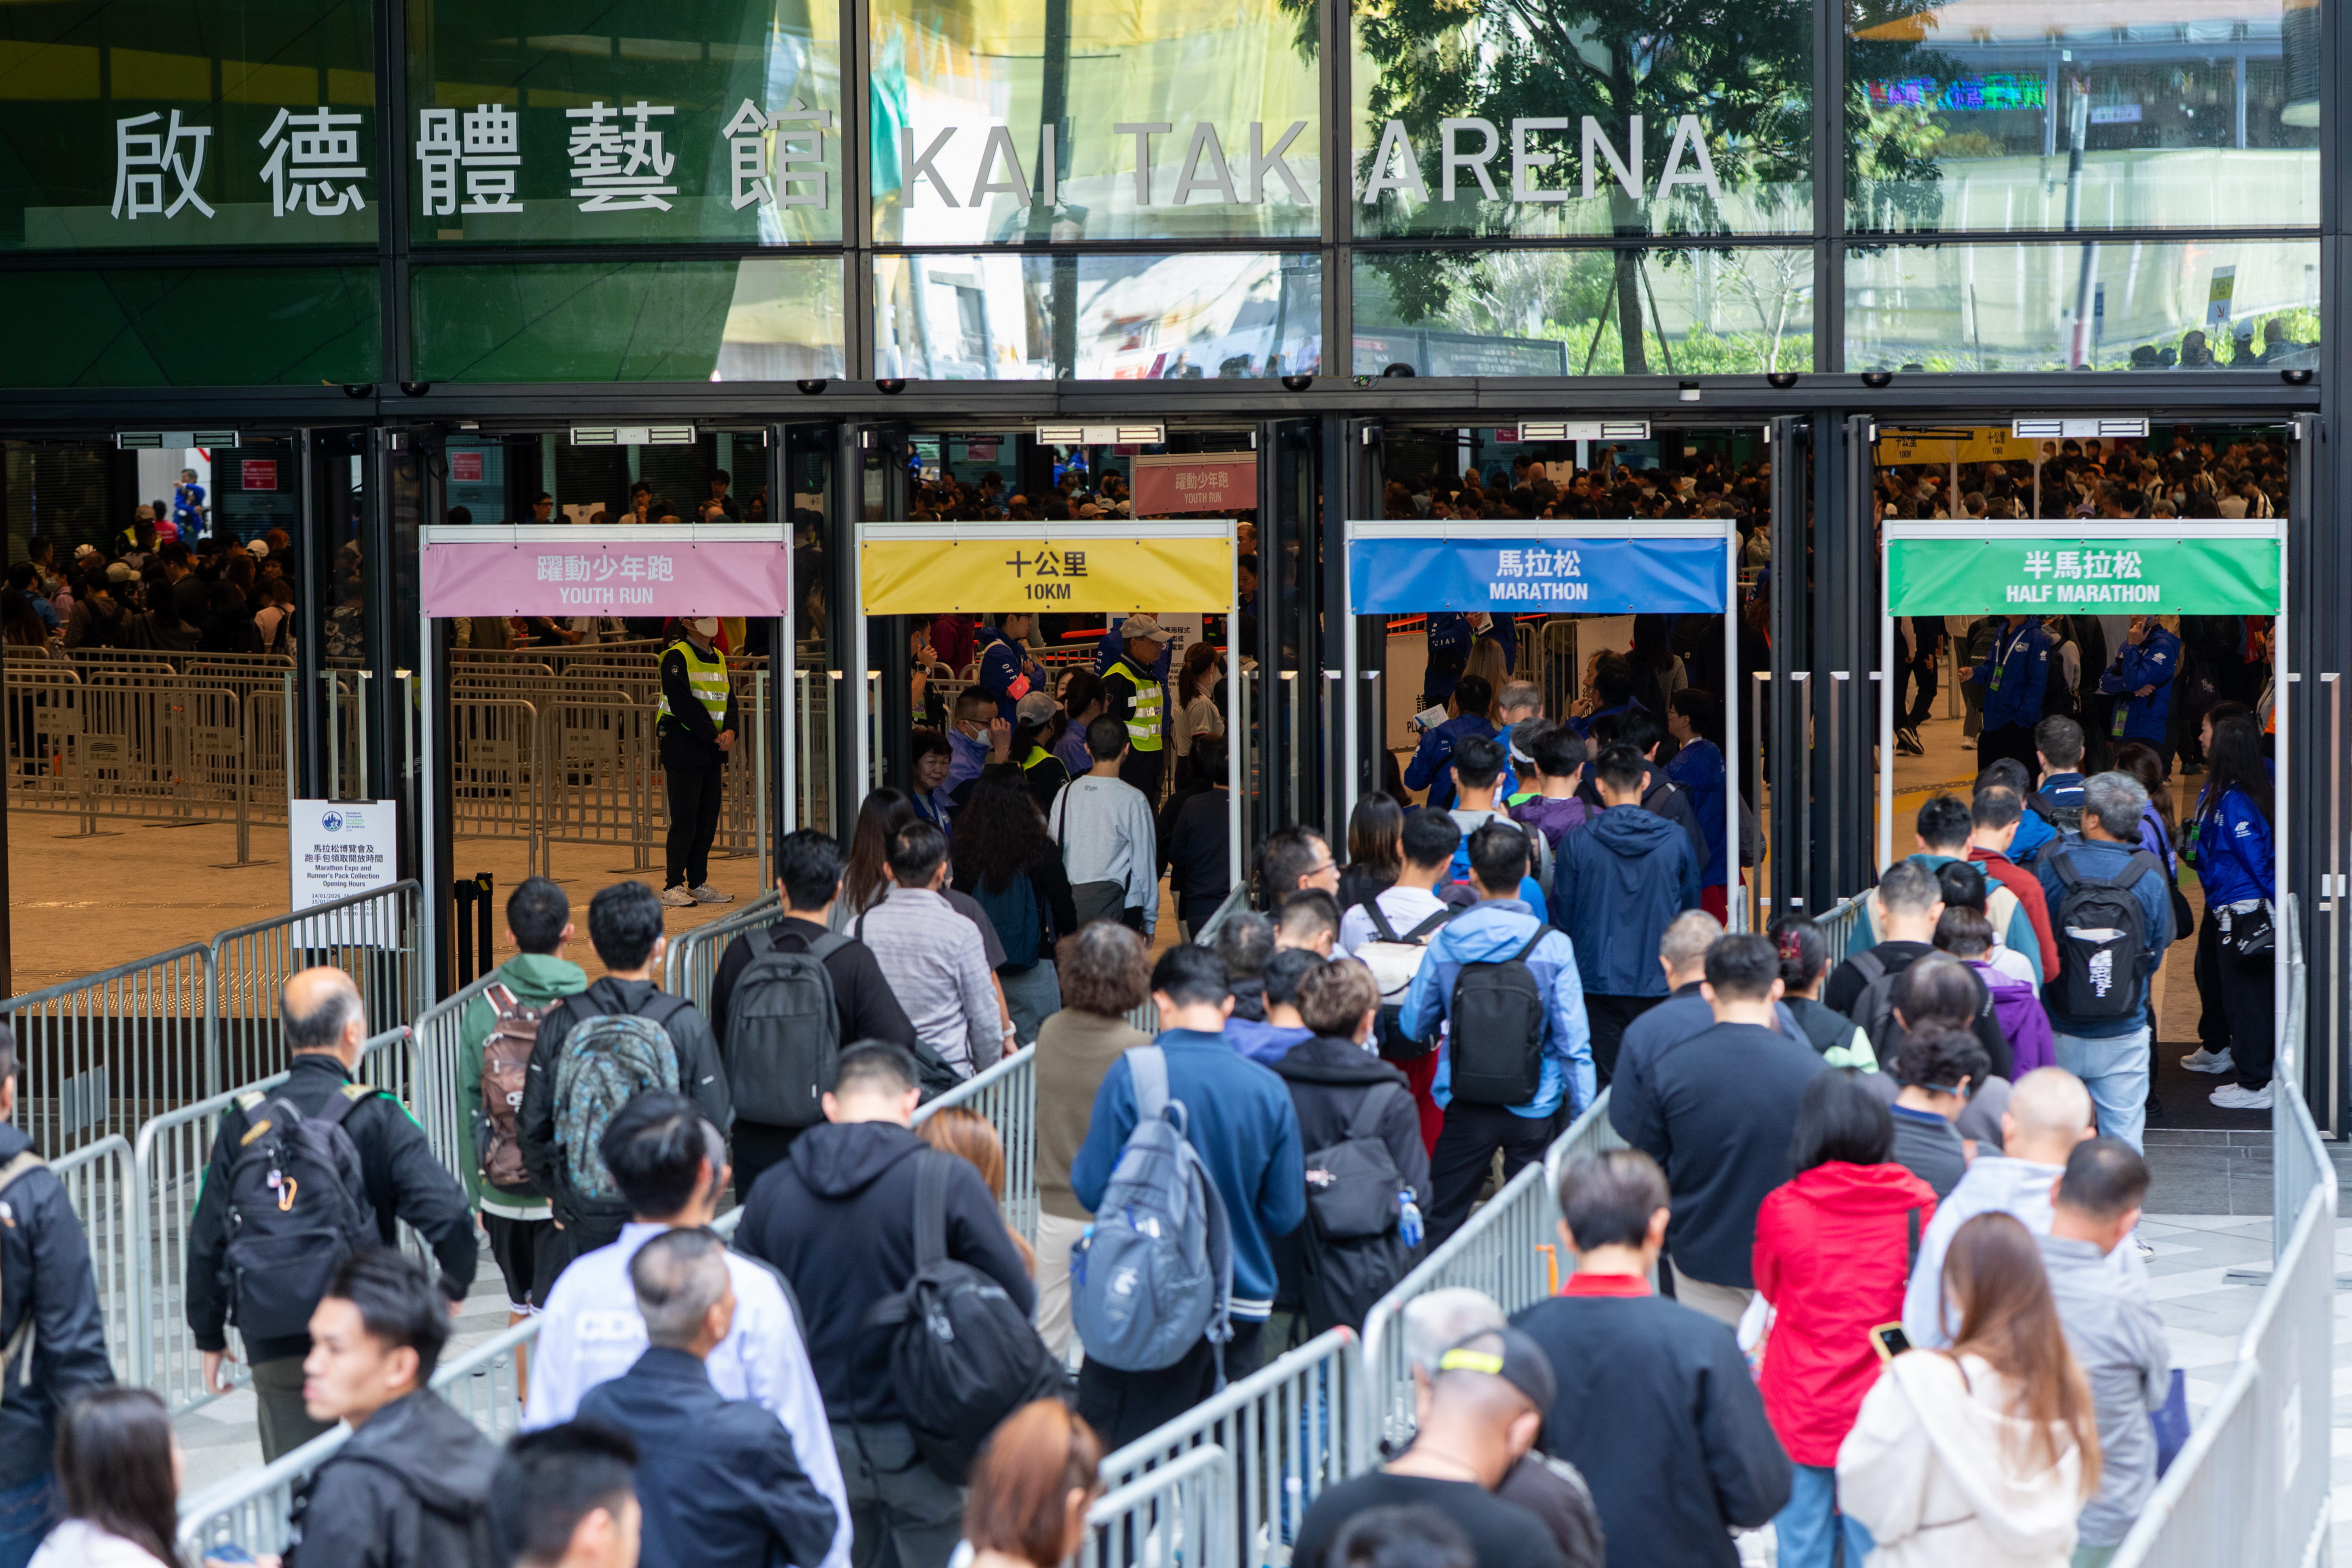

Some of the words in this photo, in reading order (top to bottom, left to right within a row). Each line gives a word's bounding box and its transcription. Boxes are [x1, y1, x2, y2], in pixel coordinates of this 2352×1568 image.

[111, 98, 830, 220] 啟德體藝館
[902, 124, 1056, 208] KAI
[1113, 121, 1311, 205] TAK
[1363, 114, 1722, 204] ARENA
[1988, 431, 2006, 444] 十公里
[1899, 450, 1911, 458] 10KM
[1176, 471, 1228, 490] 躍動少年跑
[1184, 493, 1207, 504] YOUTH
[1209, 492, 1222, 503] RUN
[537, 555, 674, 582] 躍動少年跑
[1006, 550, 1088, 578] 十公里
[1496, 549, 1581, 578] 馬拉松
[2023, 550, 2142, 580] 半馬拉松
[559, 587, 614, 604] YOUTH
[620, 587, 653, 604] RUN
[1024, 584, 1070, 600] 10KM
[1490, 582, 1588, 600] MARATHON
[2006, 584, 2052, 602] HALF
[2058, 584, 2160, 603] MARATHON
[314, 844, 374, 853] 馬拉松博覽會及
[304, 854, 383, 863] 跑手包領取開放時間
[2089, 967, 2097, 984] THE
[2096, 967, 2106, 998] NORTH
[2104, 967, 2112, 988] FACE
